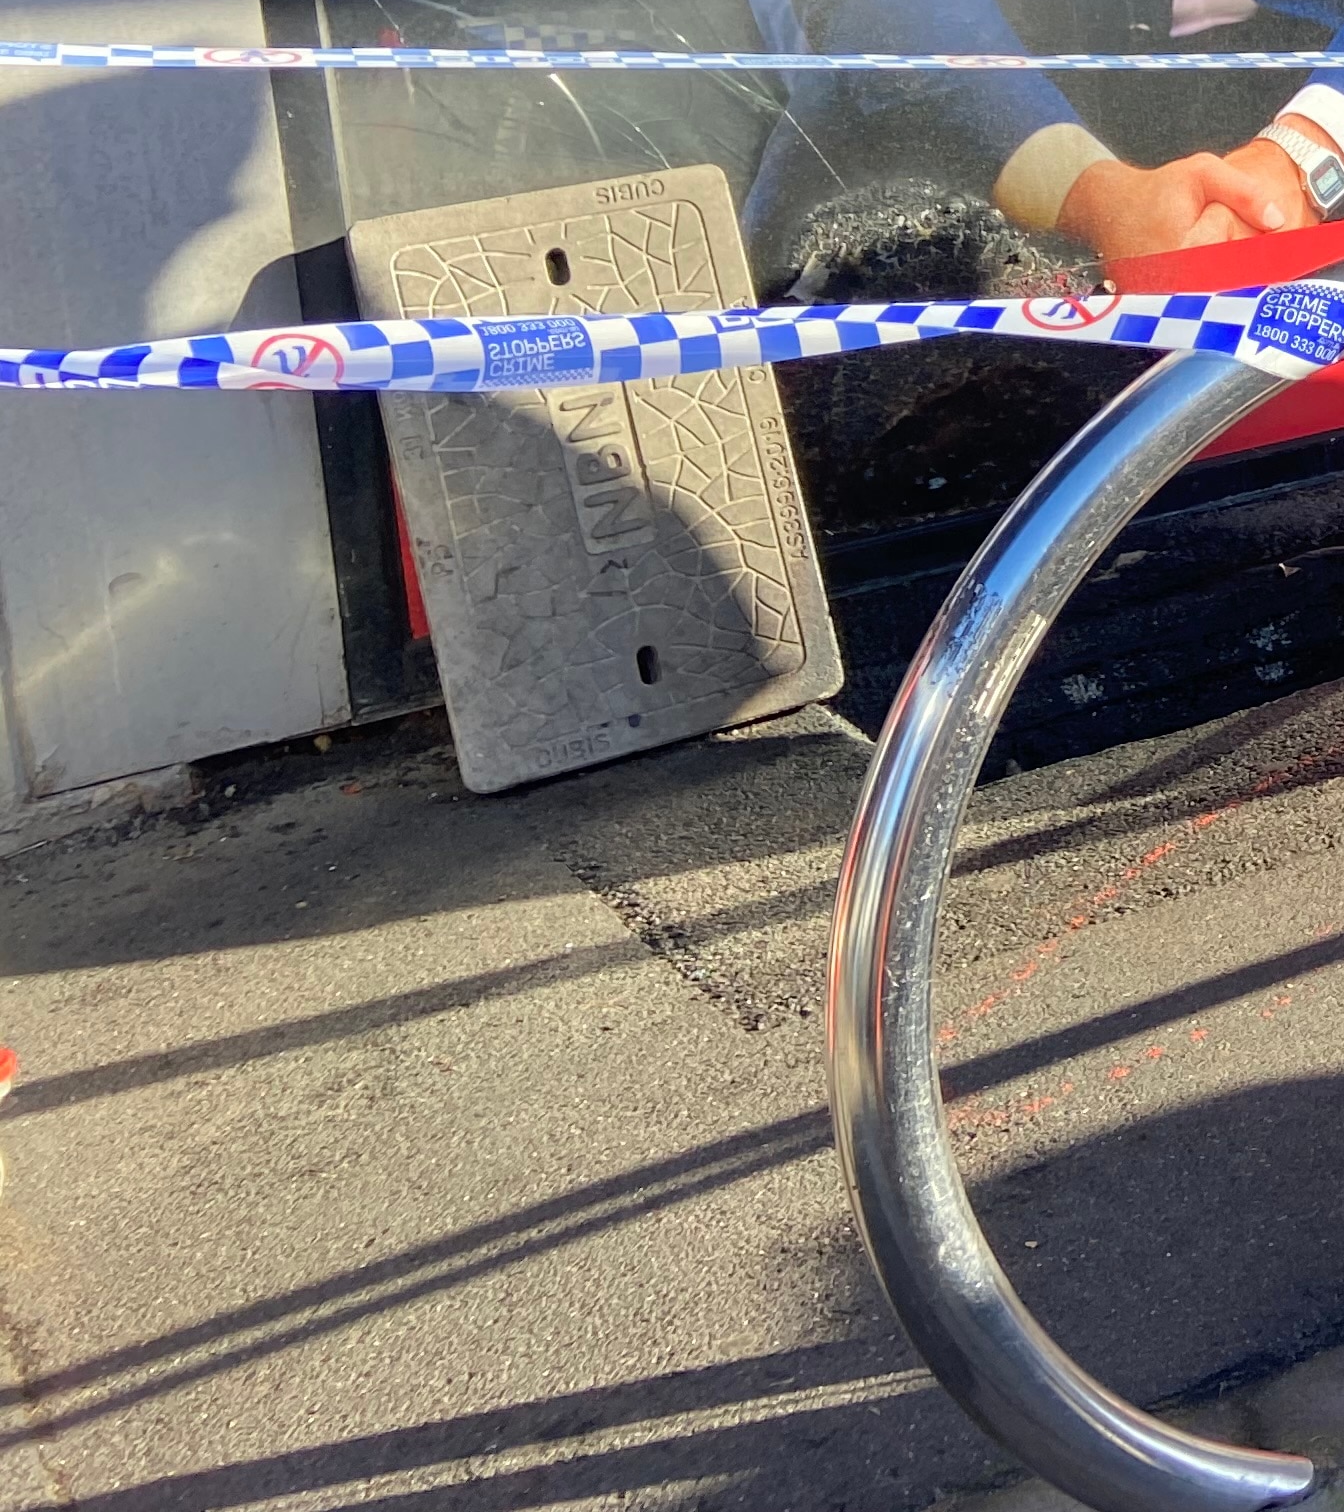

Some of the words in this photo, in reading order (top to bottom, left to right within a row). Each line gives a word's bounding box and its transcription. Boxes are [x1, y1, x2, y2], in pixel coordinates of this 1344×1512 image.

[594, 177, 666, 207] CUBIS
[1266, 292, 1331, 317] CRIME
[1253, 323, 1289, 345] 1800
[1290, 334, 1316, 355] 333
[1314, 345, 1337, 362] 000
[557, 391, 651, 550] NBN
[762, 415, 809, 561] AS3996:2019
[536, 734, 612, 771] CUBIS
